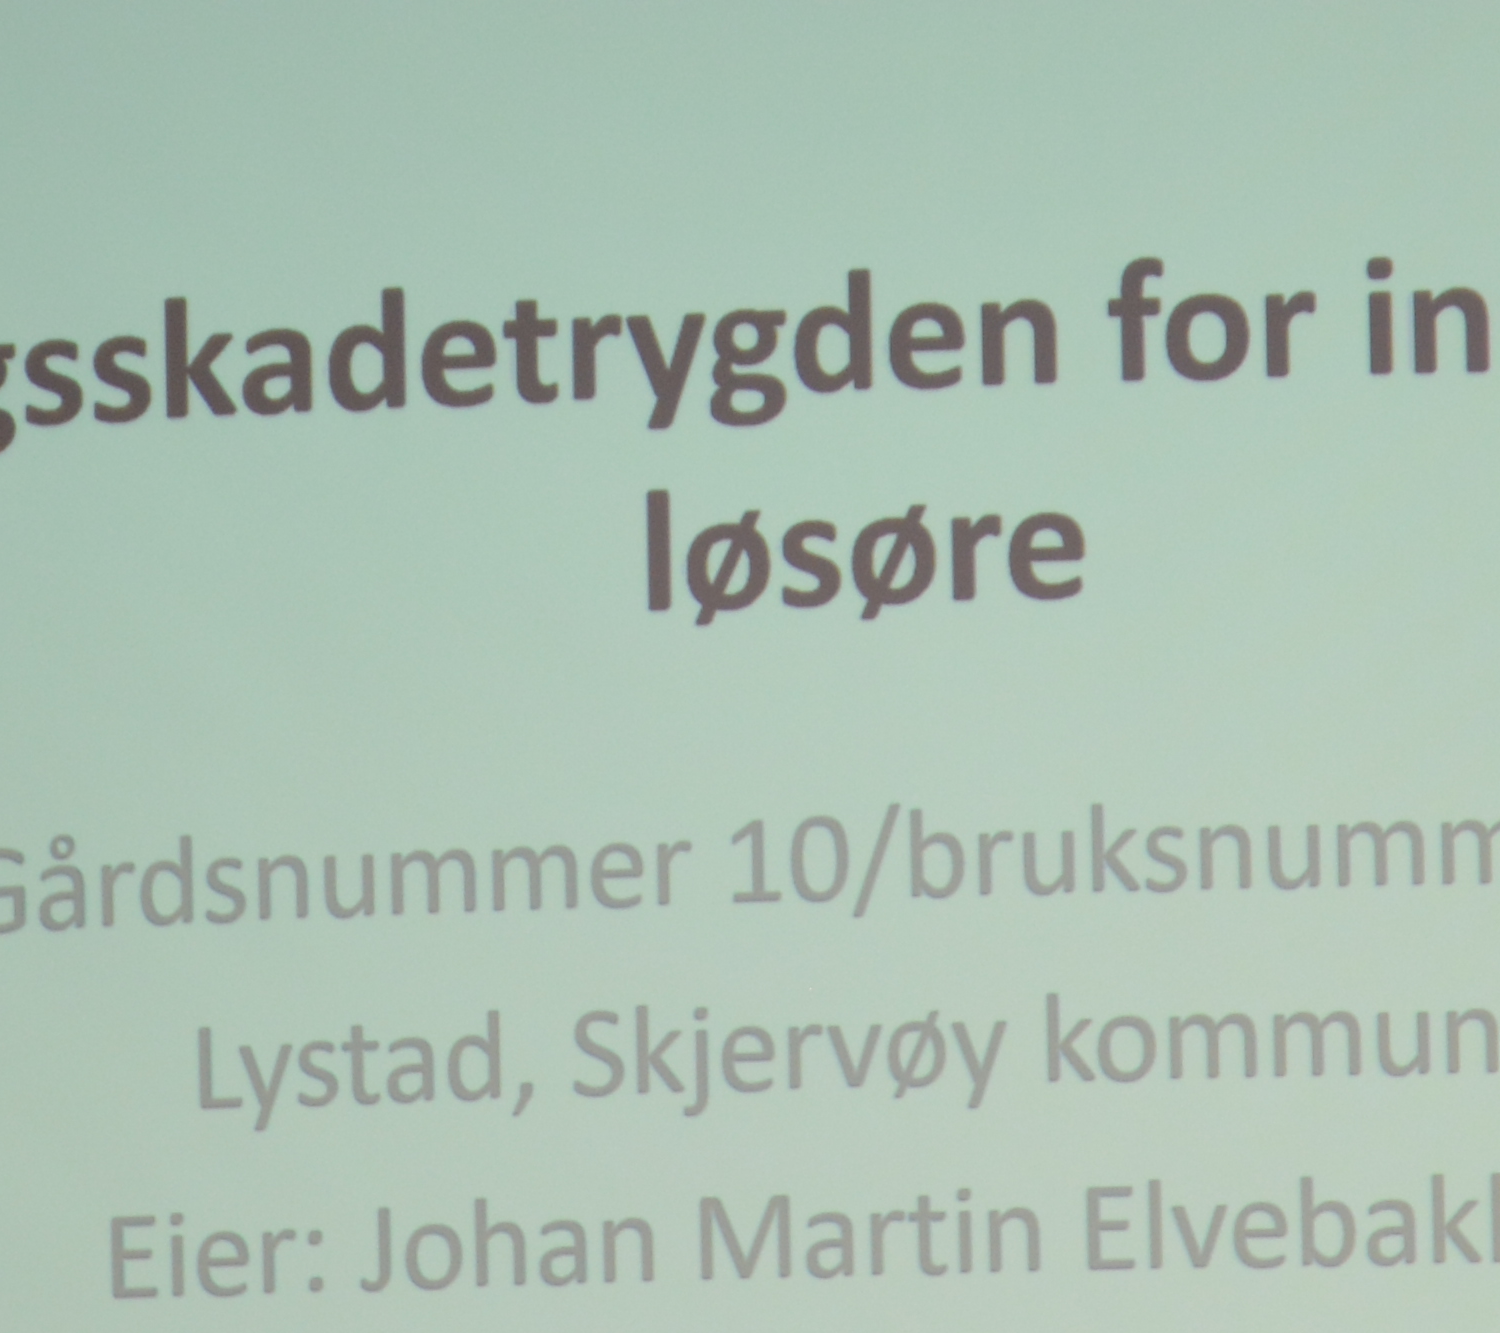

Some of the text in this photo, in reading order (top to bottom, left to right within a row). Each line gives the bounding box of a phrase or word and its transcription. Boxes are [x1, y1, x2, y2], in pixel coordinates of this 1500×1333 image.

[1105, 255, 1317, 384] for
[644, 487, 1086, 628] løsøre
[198, 1010, 533, 1132] Lystad,
[573, 1005, 1006, 1117] Skjervøy
[110, 1212, 323, 1299] Eier:
[360, 1198, 654, 1293] Johan
[699, 1188, 1040, 1280] Martin
